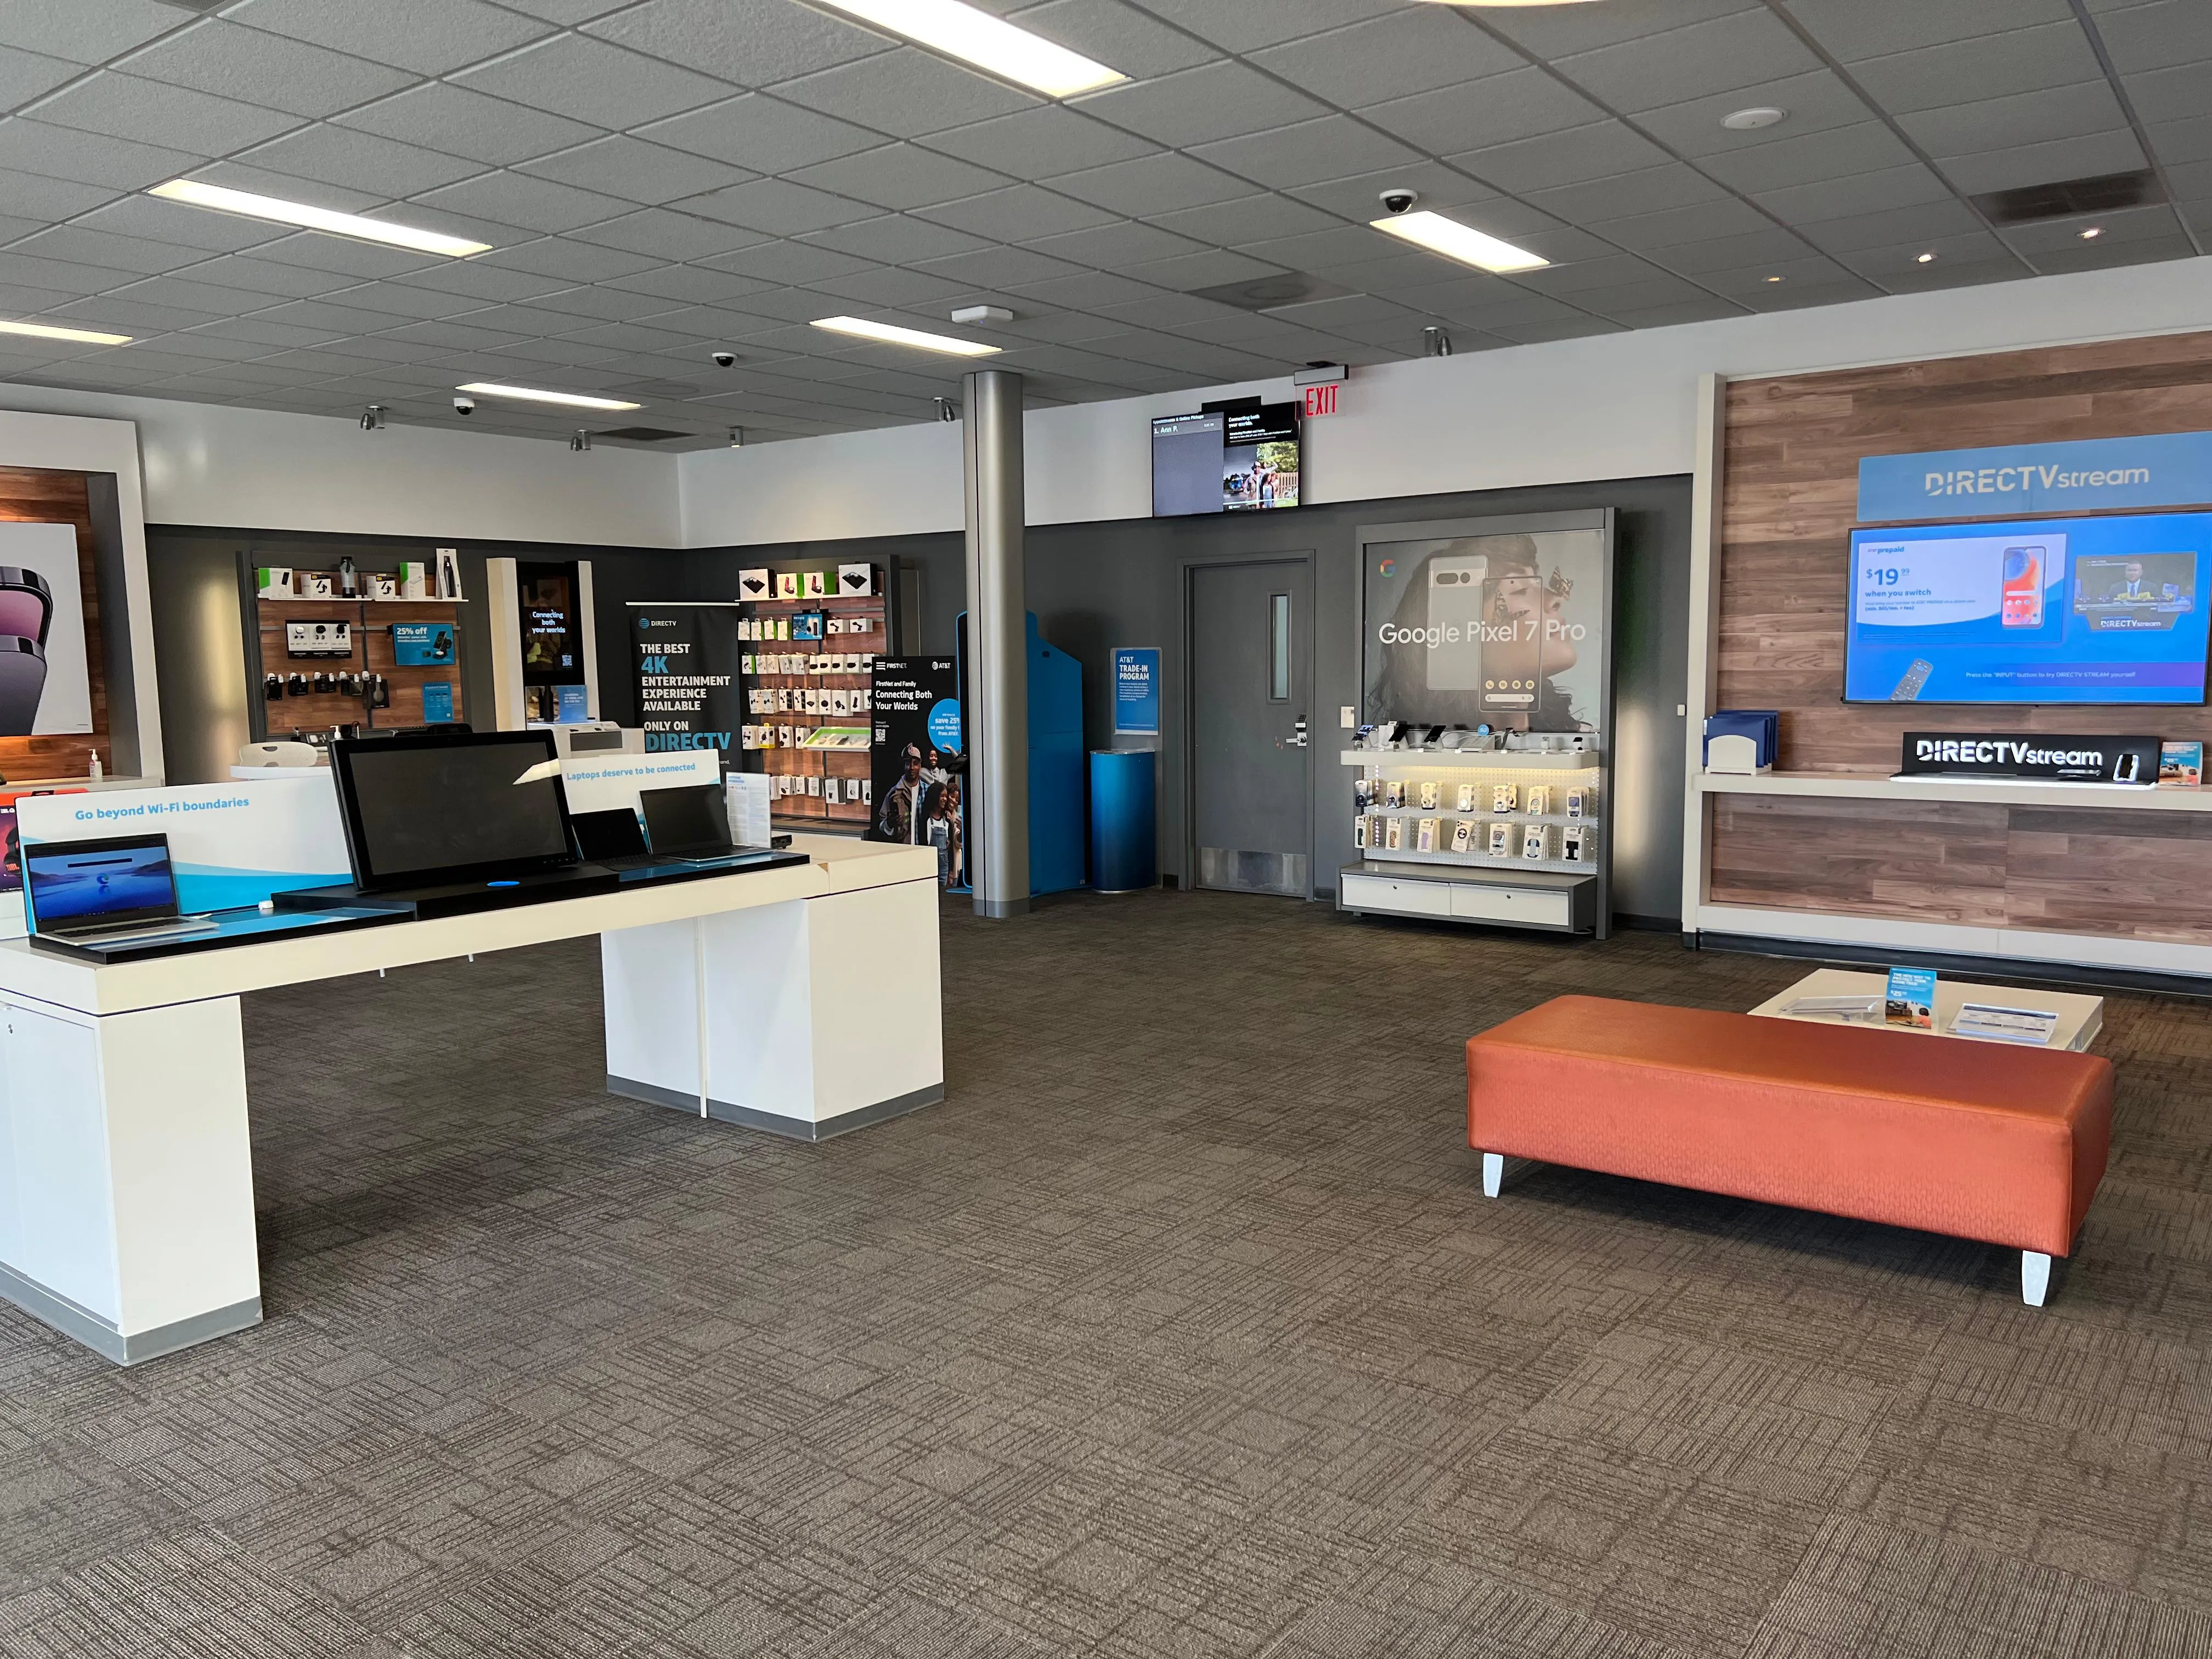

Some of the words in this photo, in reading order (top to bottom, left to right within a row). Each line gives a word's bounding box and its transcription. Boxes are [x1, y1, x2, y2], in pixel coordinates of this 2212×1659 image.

[1306, 385, 1339, 415] EXIT
[1877, 546, 1904, 555] prepaid
[1905, 588, 1931, 596] switch
[532, 611, 564, 619] Connecting
[1379, 622, 1460, 648] Google
[1467, 620, 1517, 642] Pixel
[1525, 620, 1538, 641] 7
[1546, 619, 1586, 641] Pro
[640, 644, 662, 653] THE
[664, 644, 691, 653] BEST
[641, 656, 669, 674] 4K
[641, 676, 731, 686] ENTERTAINMENT
[642, 689, 707, 698] EXPERIENCE
[876, 690, 913, 700] Connecting
[916, 690, 932, 698] Both
[643, 701, 701, 711] AVAILABLE
[876, 702, 892, 710] Your
[894, 702, 918, 710] Worlds
[644, 721, 672, 731] ONLY
[673, 721, 689, 731] ON
[645, 732, 731, 751] DIRECTV
[567, 772, 600, 781] Laptops
[602, 769, 633, 778] deserve
[657, 763, 696, 772] connected
[75, 810, 93, 820] Go
[97, 805, 144, 820] beyond
[147, 802, 179, 814] Wi-Fi
[183, 797, 250, 811] boundaries
